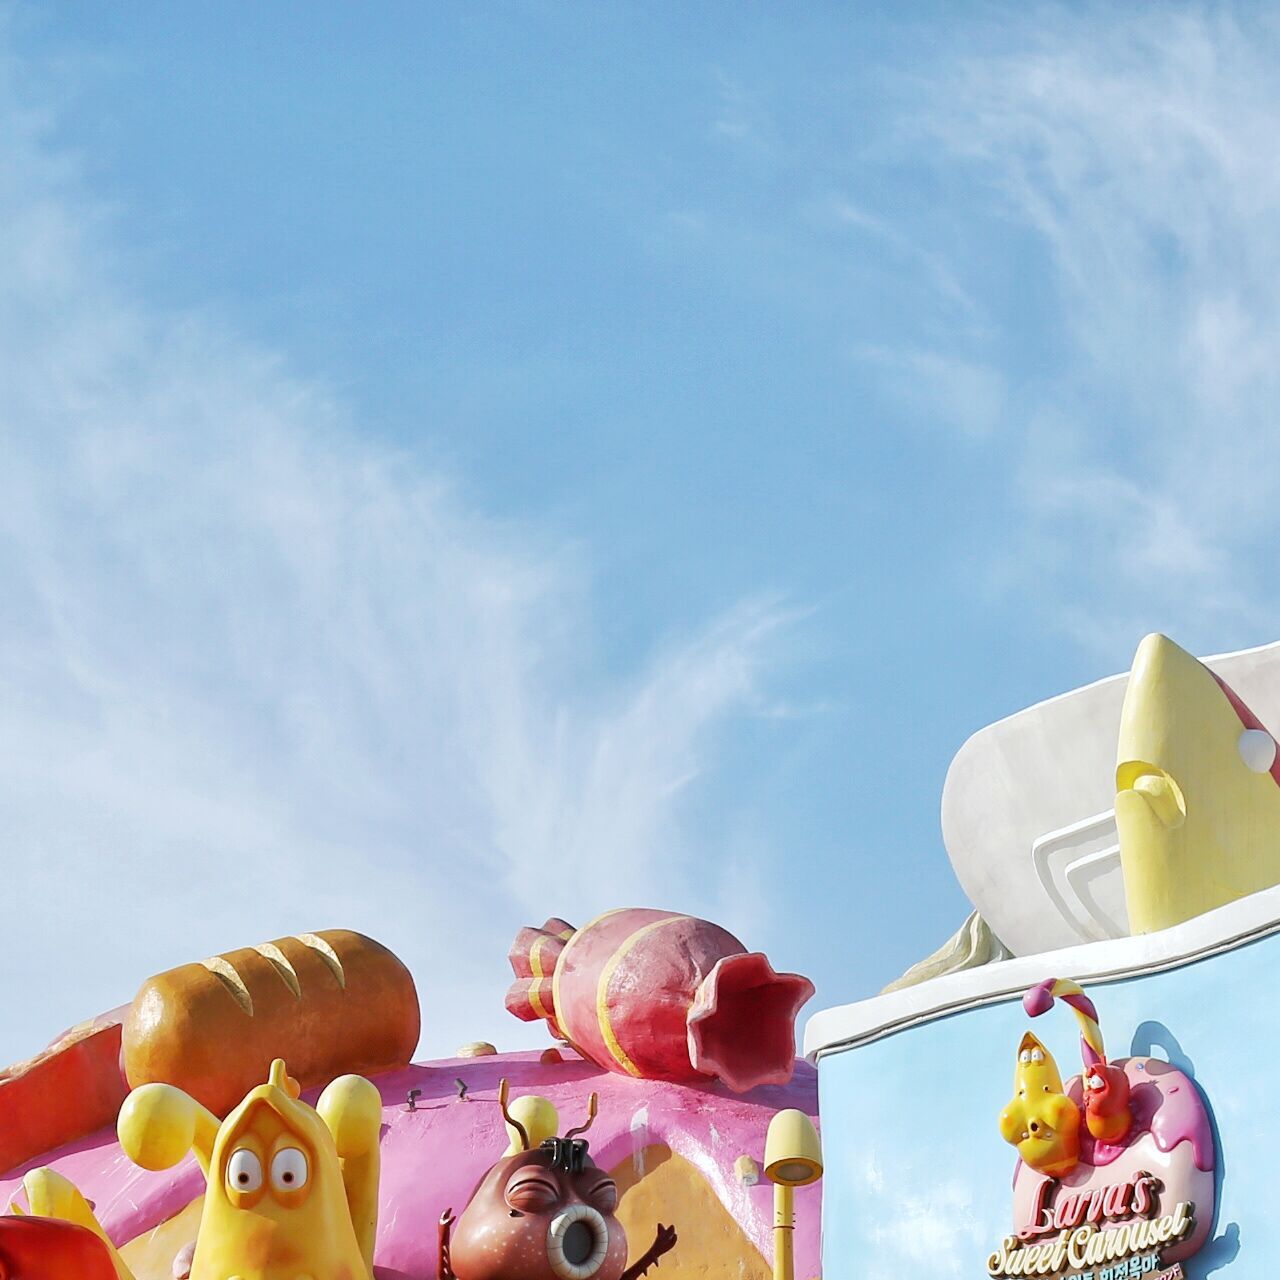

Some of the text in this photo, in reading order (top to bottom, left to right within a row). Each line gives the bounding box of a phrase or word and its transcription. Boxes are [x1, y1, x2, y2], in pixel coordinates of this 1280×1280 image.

[986, 1202, 1187, 1277] Sweet Carousel
[1021, 1172, 1158, 1240] Larva's
